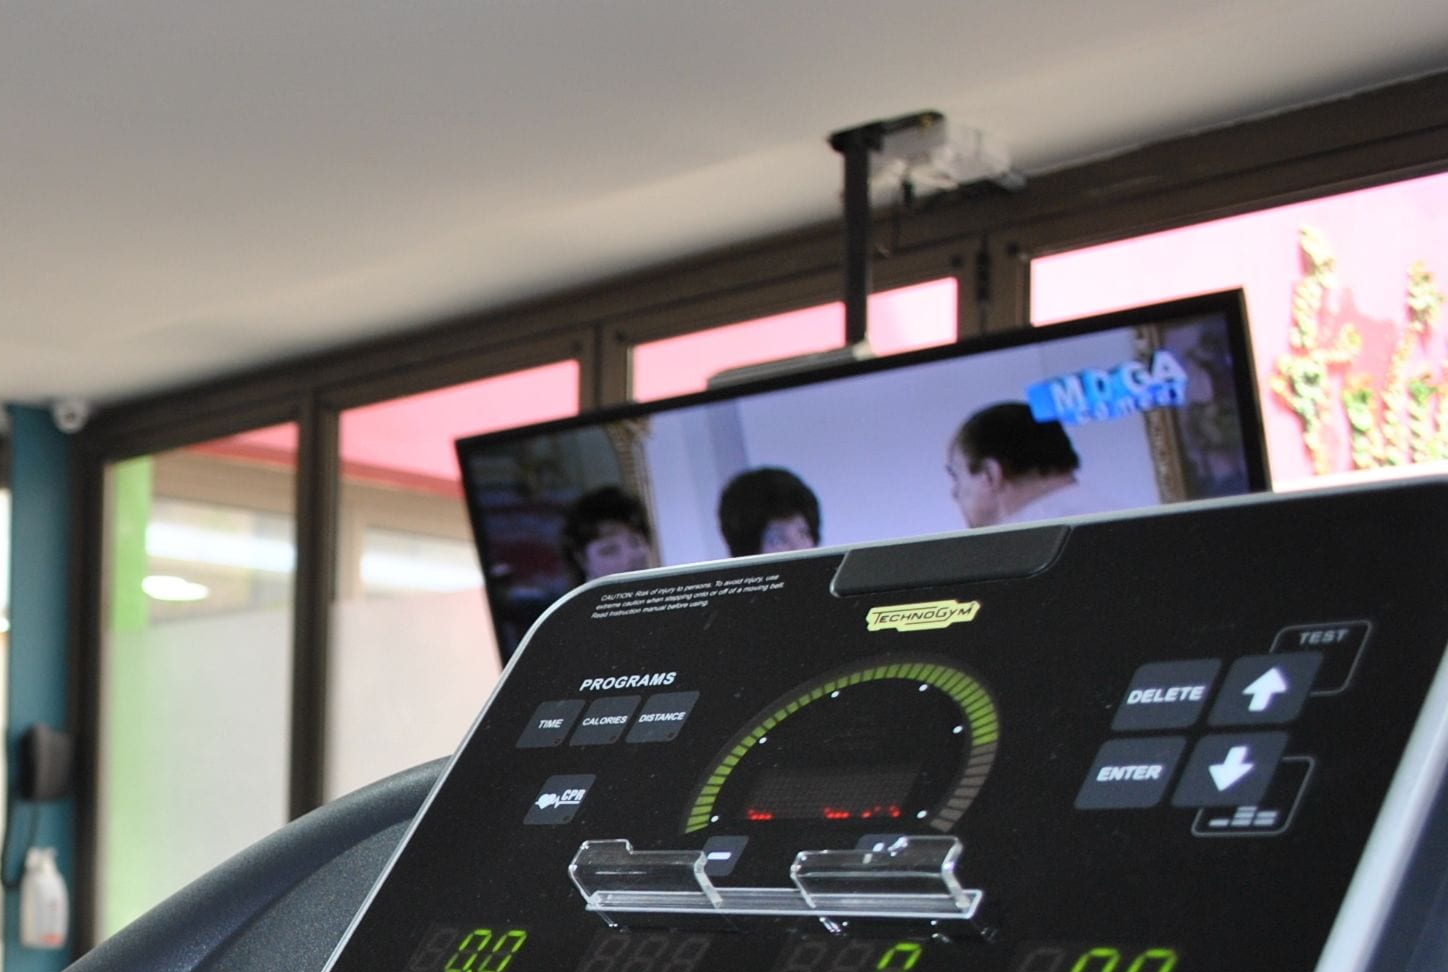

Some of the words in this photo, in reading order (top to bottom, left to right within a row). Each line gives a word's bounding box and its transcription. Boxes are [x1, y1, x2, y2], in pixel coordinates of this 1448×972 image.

[1298, 628, 1350, 646] TEST
[579, 672, 677, 692] PROGRAMS
[1126, 684, 1206, 705] DELETE
[538, 719, 564, 729] TIME
[582, 715, 628, 726] CALORIES
[638, 711, 686, 723] DISTANCE
[1095, 763, 1165, 782] ENTER
[561, 789, 586, 801] CPR
